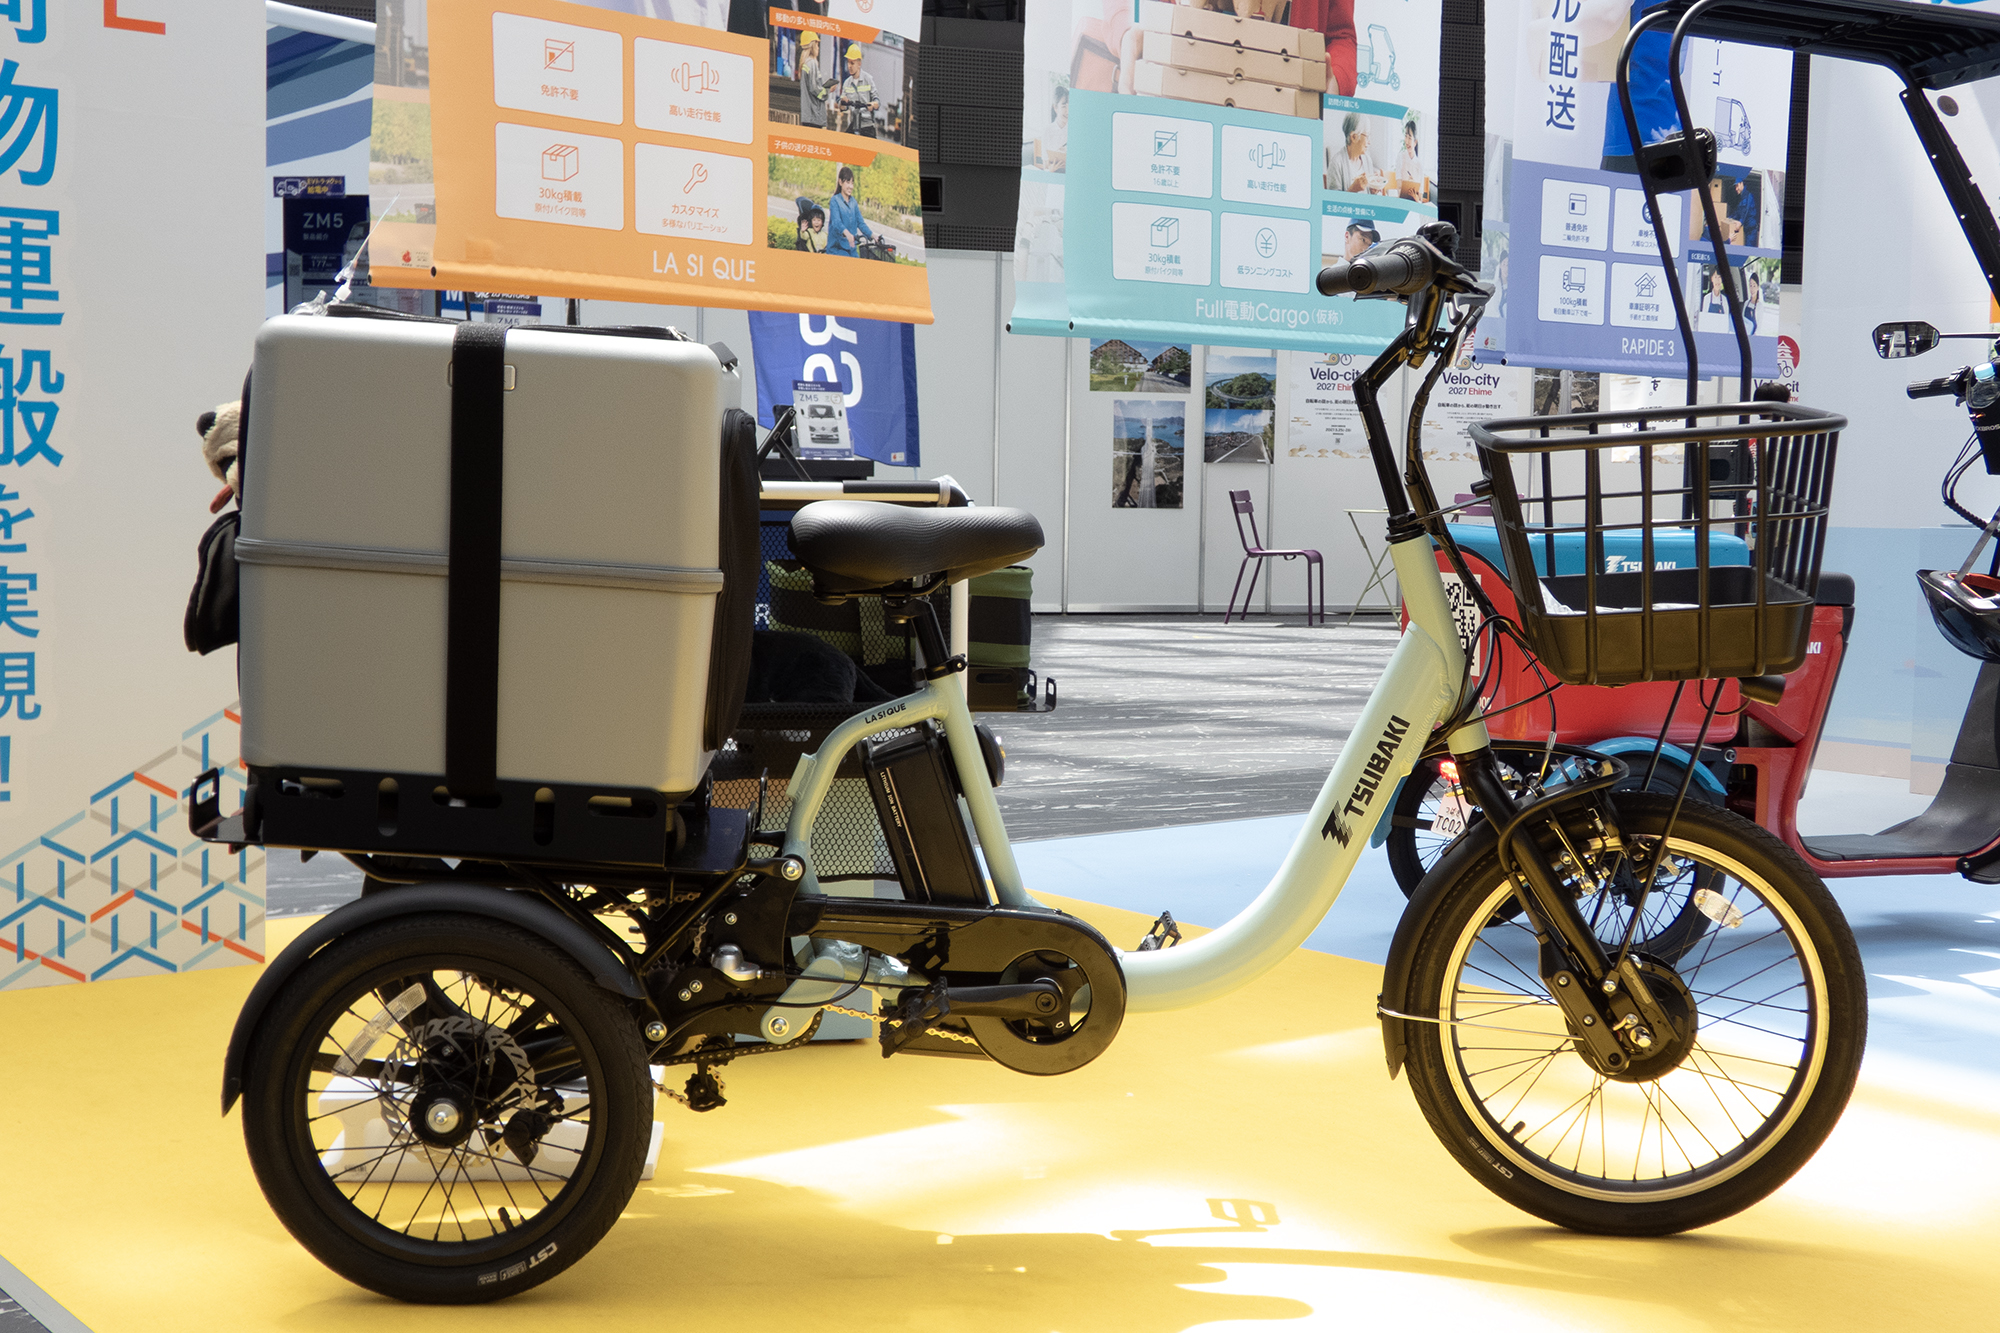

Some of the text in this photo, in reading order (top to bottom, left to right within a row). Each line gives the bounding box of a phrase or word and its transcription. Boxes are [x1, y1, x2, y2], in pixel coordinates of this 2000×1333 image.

[775, 12, 842, 33] 移動の多い施設内にも
[540, 84, 579, 101] 免許不要
[669, 104, 721, 123] 高い走行性能
[774, 139, 832, 156] 子供の送り迎えにも
[1150, 164, 1181, 176] 免許不要
[1153, 178, 1180, 188] 16歳以上
[1247, 179, 1288, 193] 高い走行性能
[538, 187, 583, 204] 30kg積載
[534, 202, 586, 218] 原付バイク同等
[671, 203, 720, 219] カスタマイズ
[303, 212, 344, 229] ZM5
[662, 218, 728, 234] 多様なバリエーション
[1638, 229, 1657, 239] 車検不
[653, 250, 756, 283] LA SI QUE
[1148, 253, 1182, 265] 30kg積載
[1144, 265, 1184, 277] 原付バイク同等
[1236, 264, 1294, 279] 低ランニングコスト
[1621, 337, 1675, 357] RAPIDE 3
[1310, 367, 1361, 382] Velo-cit
[1443, 372, 1500, 388] Velo-city
[1317, 382, 1352, 391] 2027 Ehi
[1448, 387, 1493, 396] 2027 Ehime
[799, 394, 819, 402] ZM5
[1343, 714, 1411, 817] TSUBAKI
[1436, 814, 1462, 835] TC02
[1491, 1162, 1514, 1179] CST
[528, 1241, 558, 1269] CST
